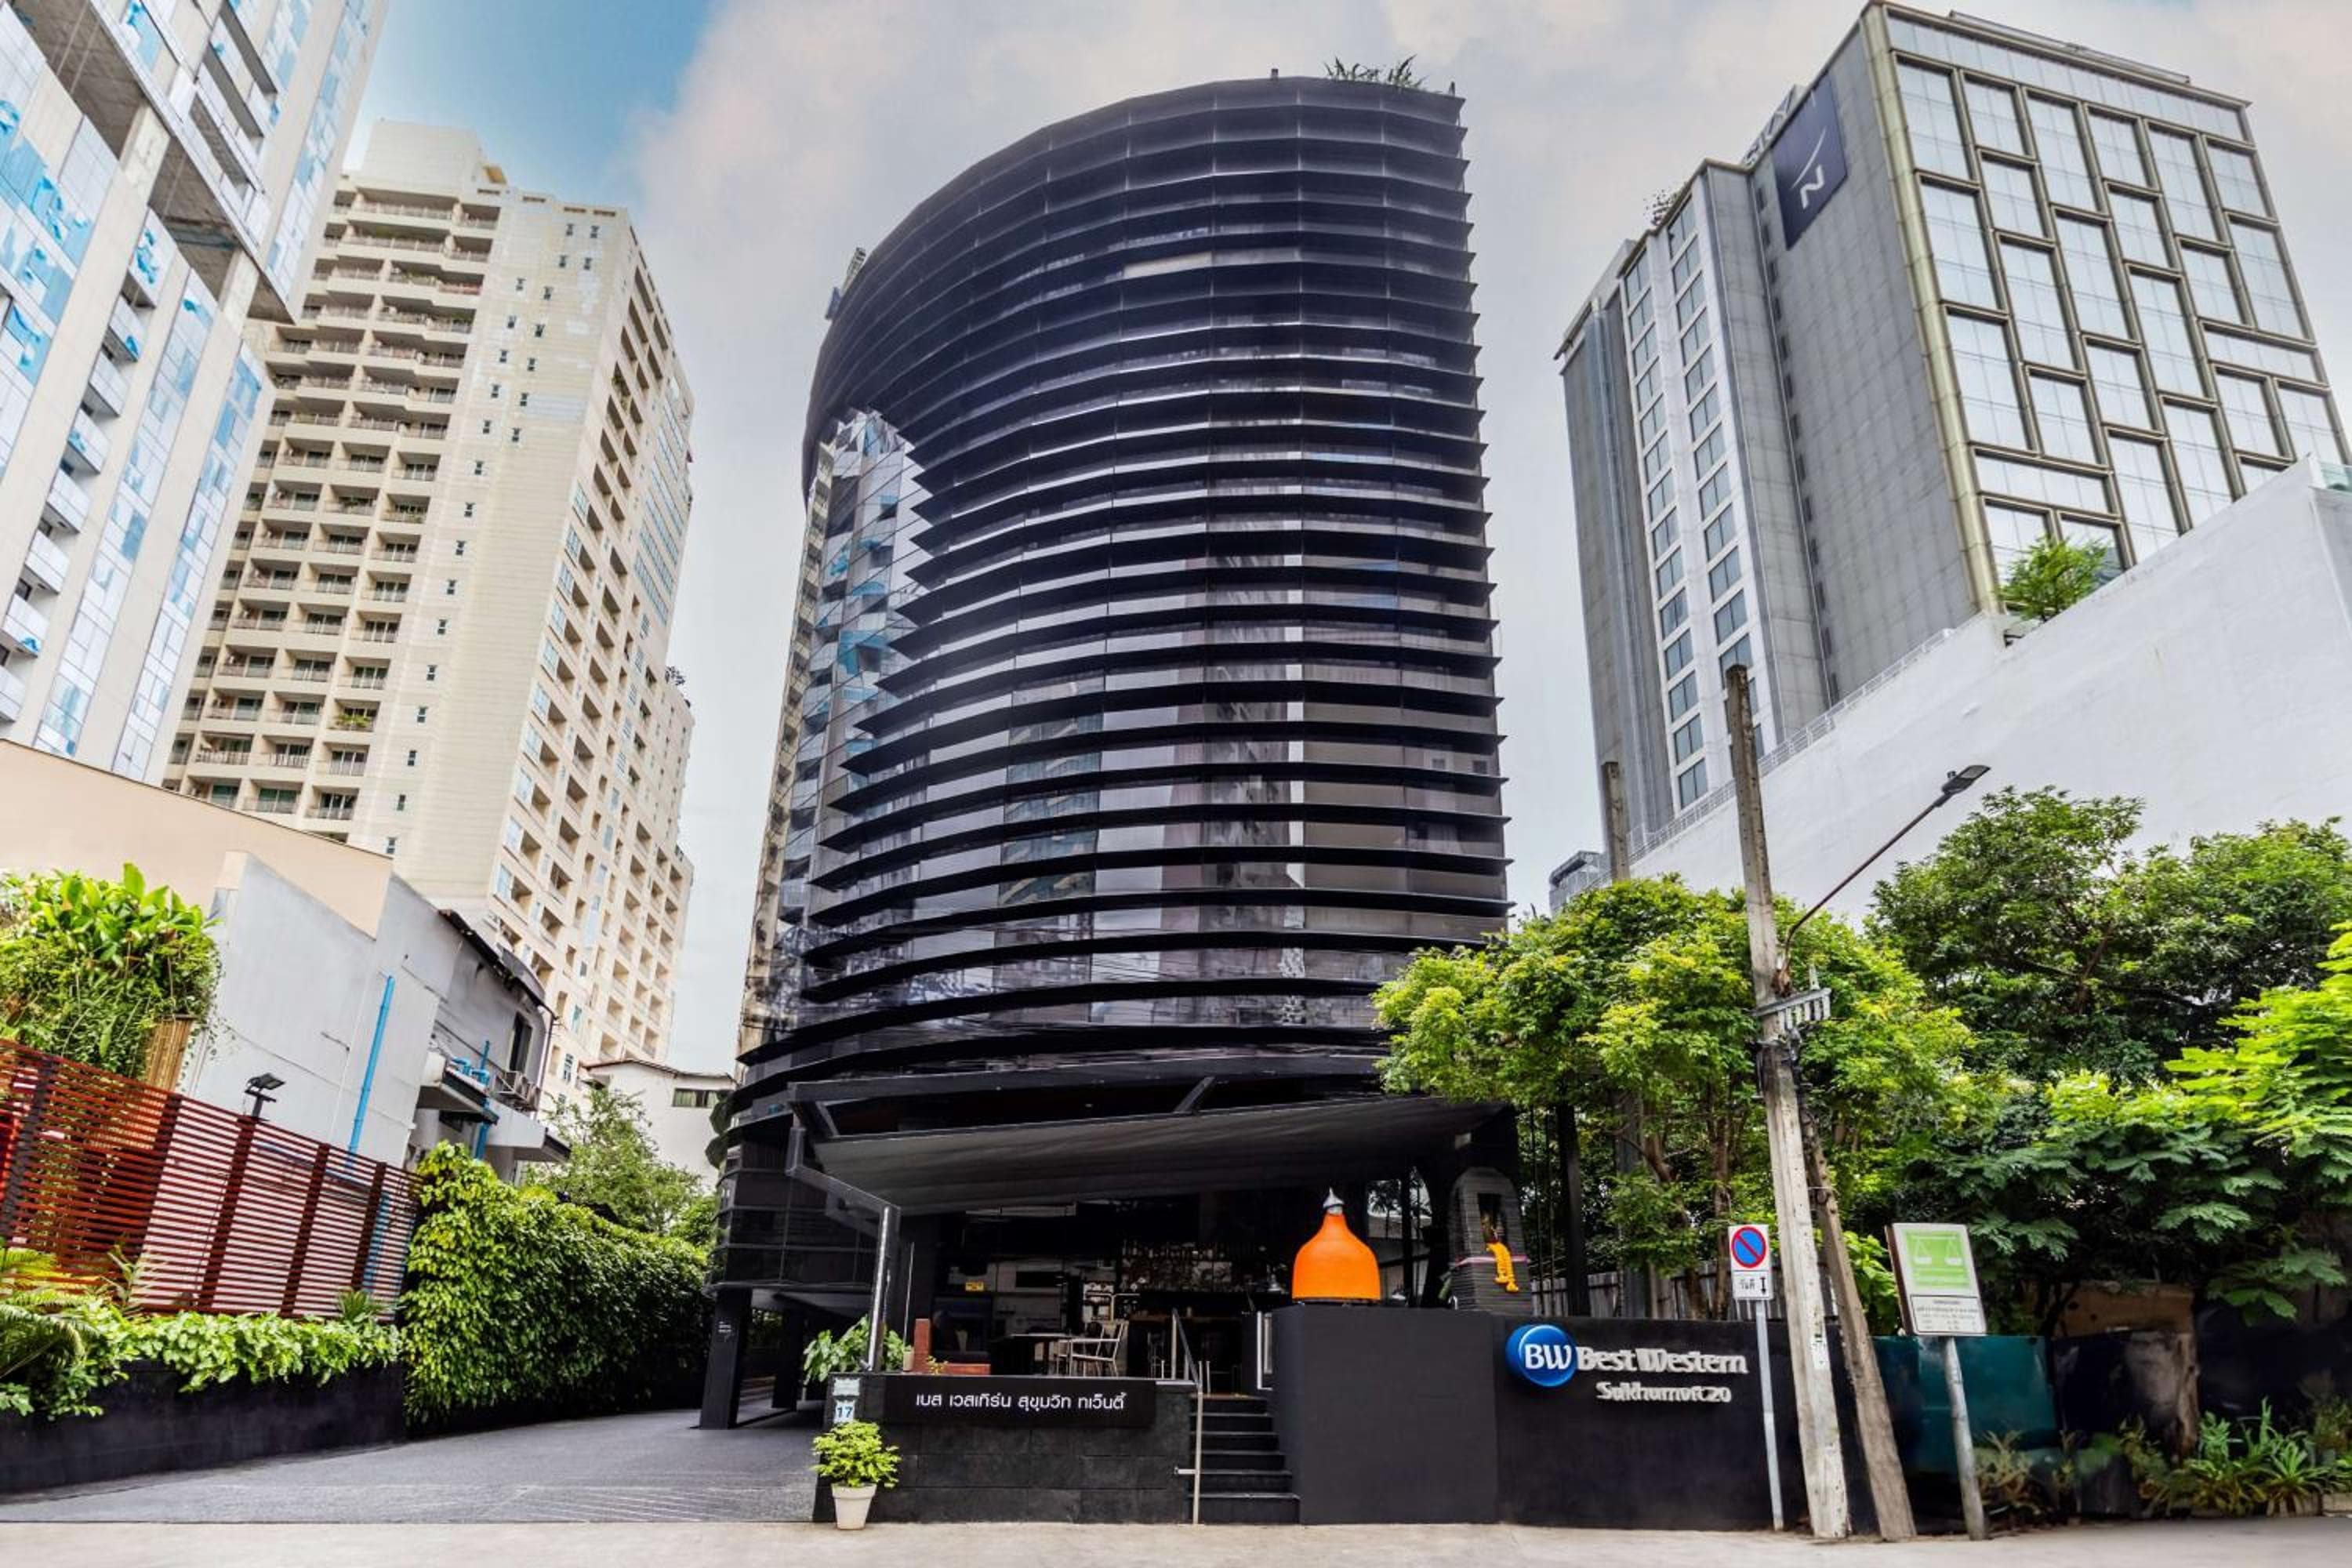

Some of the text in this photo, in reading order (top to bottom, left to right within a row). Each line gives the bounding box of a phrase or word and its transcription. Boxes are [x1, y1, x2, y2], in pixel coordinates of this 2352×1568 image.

[1525, 1344, 1572, 1370] BW
[1575, 1346, 1748, 1374] Best Western
[916, 1391, 1127, 1412] เบส เวสเทิร์น สุขุมวิท ทเว็นตี้
[1595, 1381, 1732, 1403] Sukhumvit 20
[837, 1406, 853, 1418] 17
